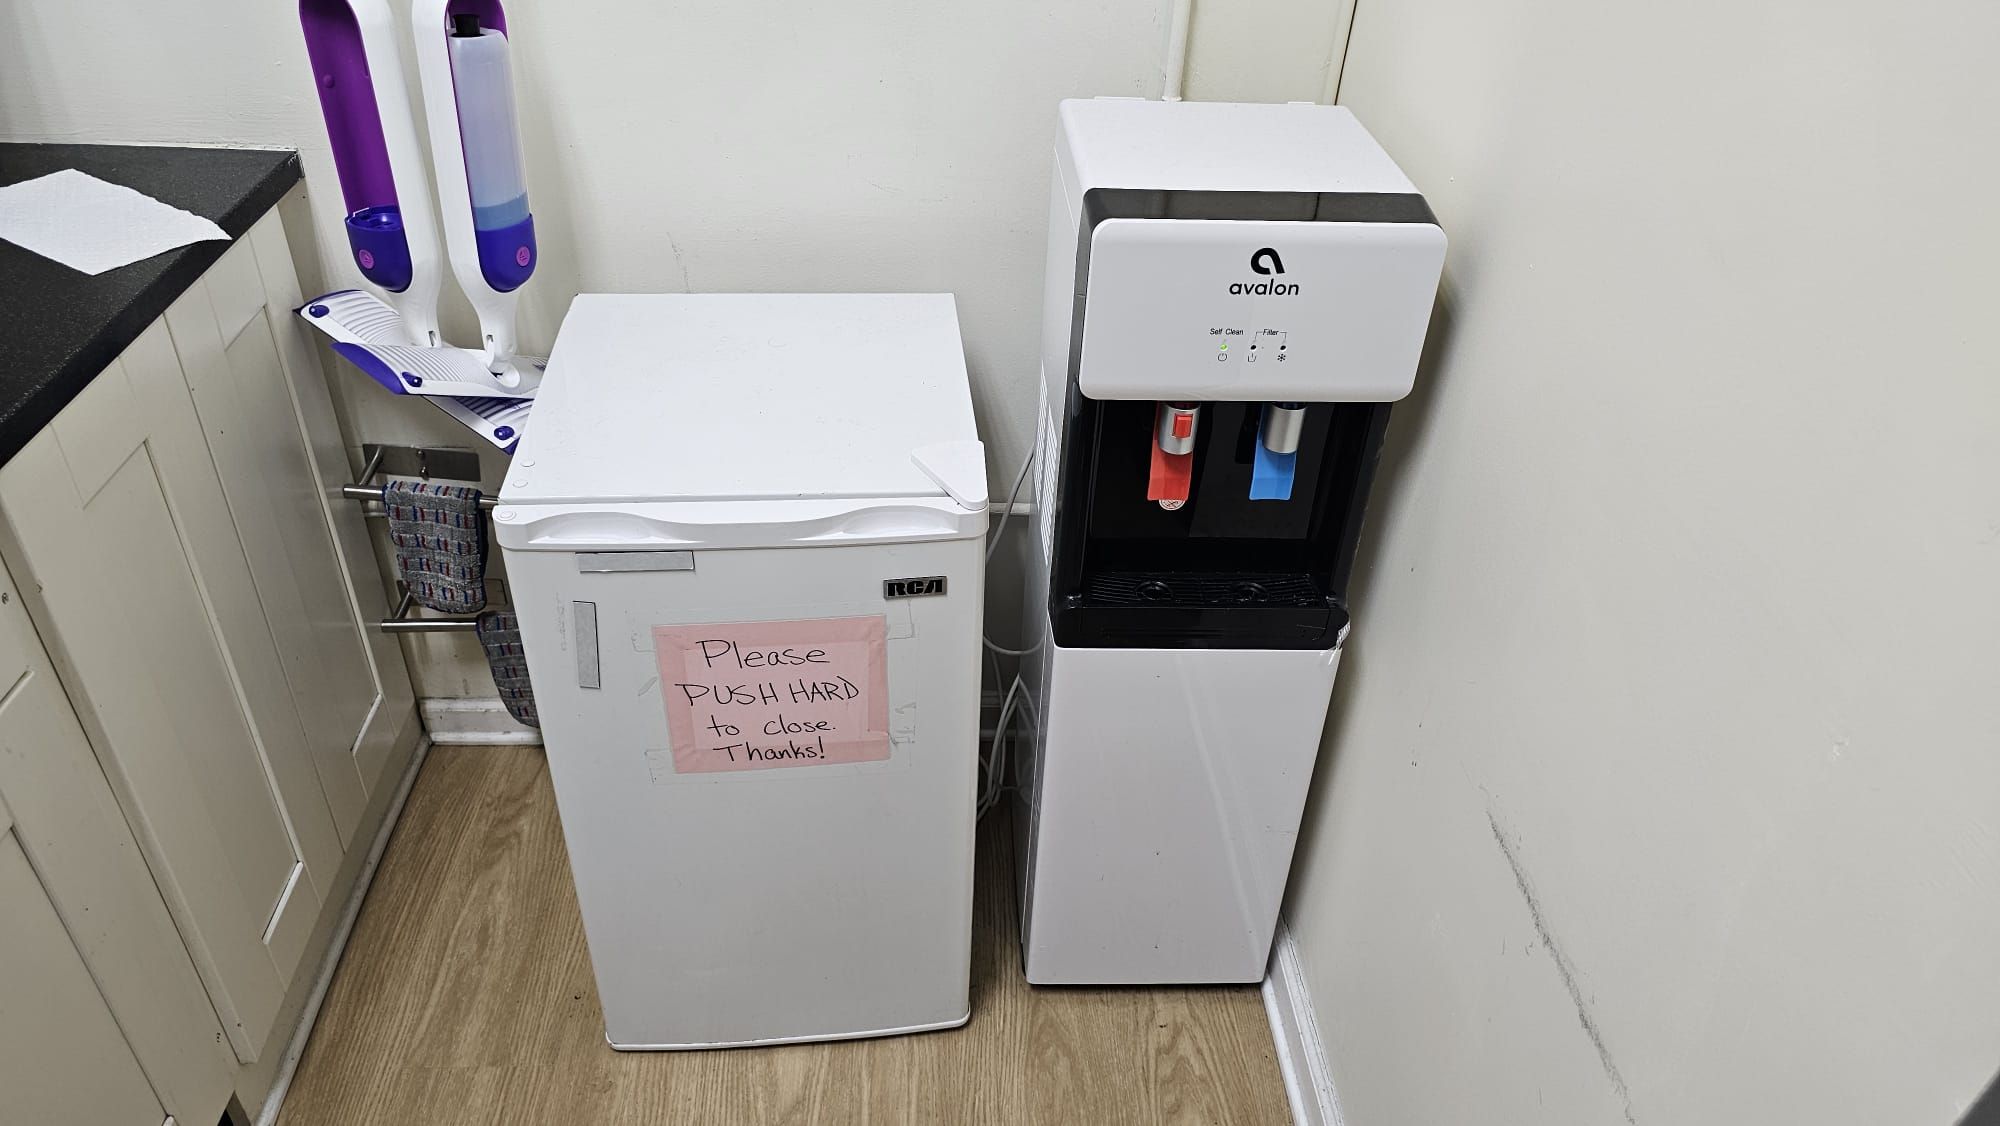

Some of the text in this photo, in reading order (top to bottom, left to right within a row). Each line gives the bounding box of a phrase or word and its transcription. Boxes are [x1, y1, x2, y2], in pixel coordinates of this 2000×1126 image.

[1229, 278, 1300, 296] avalon
[1225, 327, 1244, 336] Clean
[887, 579, 943, 597] RCA
[696, 639, 830, 669] Please
[675, 675, 860, 706] PUSH HARD
[707, 714, 836, 737] to close.
[713, 736, 826, 763] Thanks!
